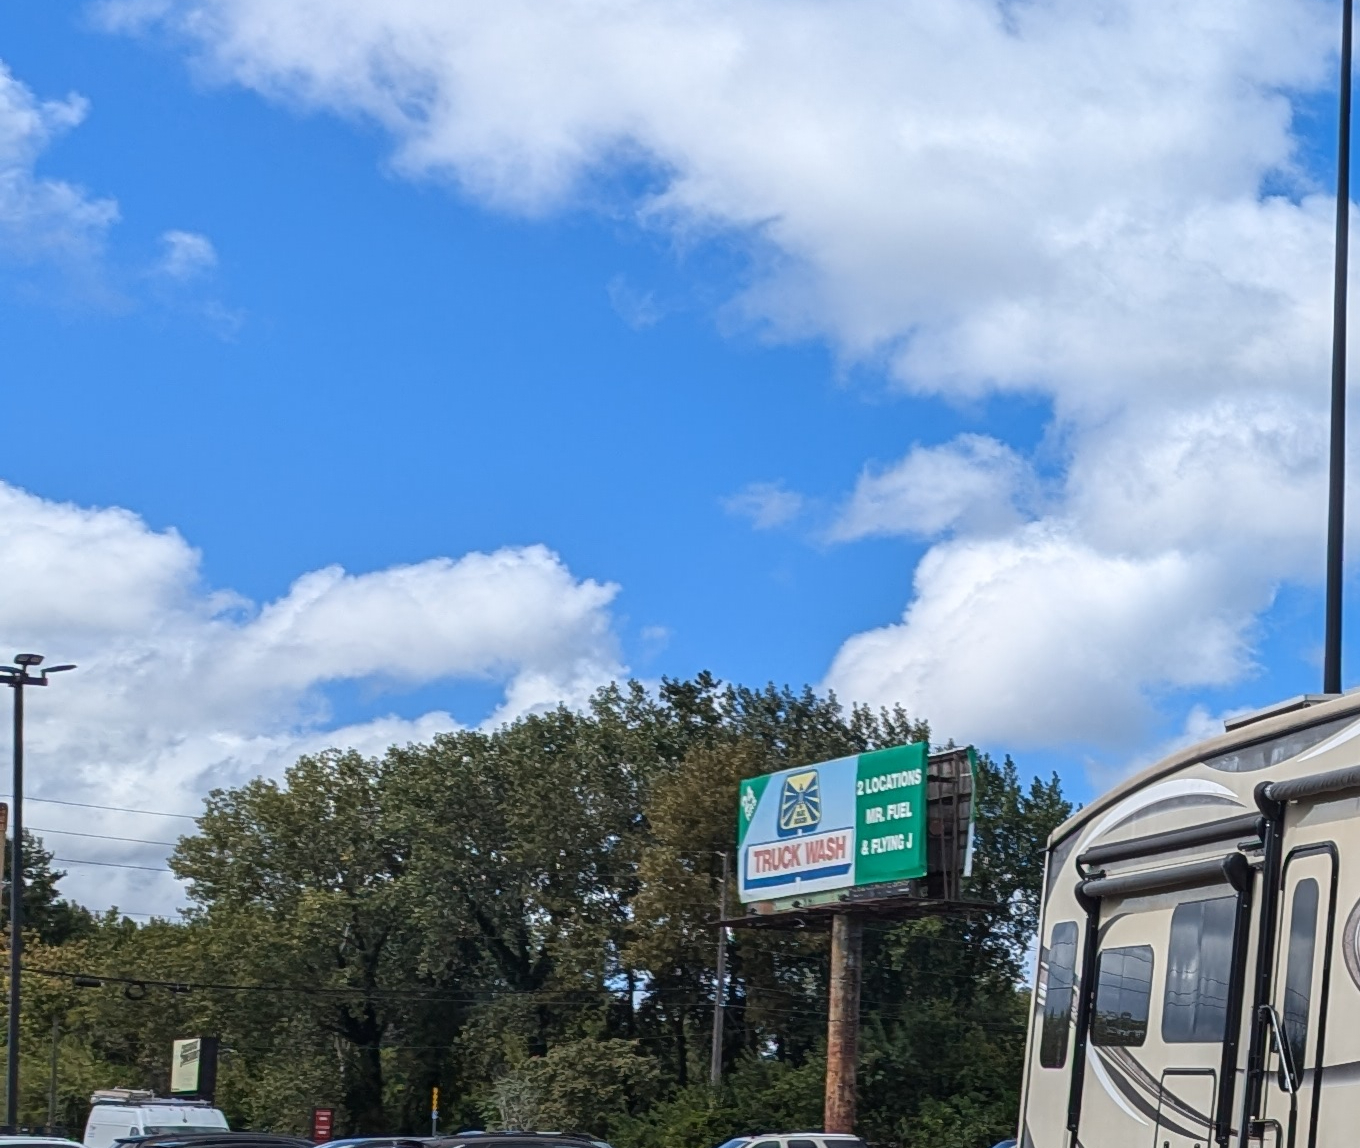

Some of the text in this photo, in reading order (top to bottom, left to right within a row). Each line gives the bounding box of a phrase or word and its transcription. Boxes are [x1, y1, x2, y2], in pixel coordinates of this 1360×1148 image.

[857, 768, 922, 796] 2 LOCATIONS
[865, 801, 913, 825] MR. FUEL
[754, 835, 847, 873] TRUCK WASH
[861, 832, 914, 856] & FLYING J
